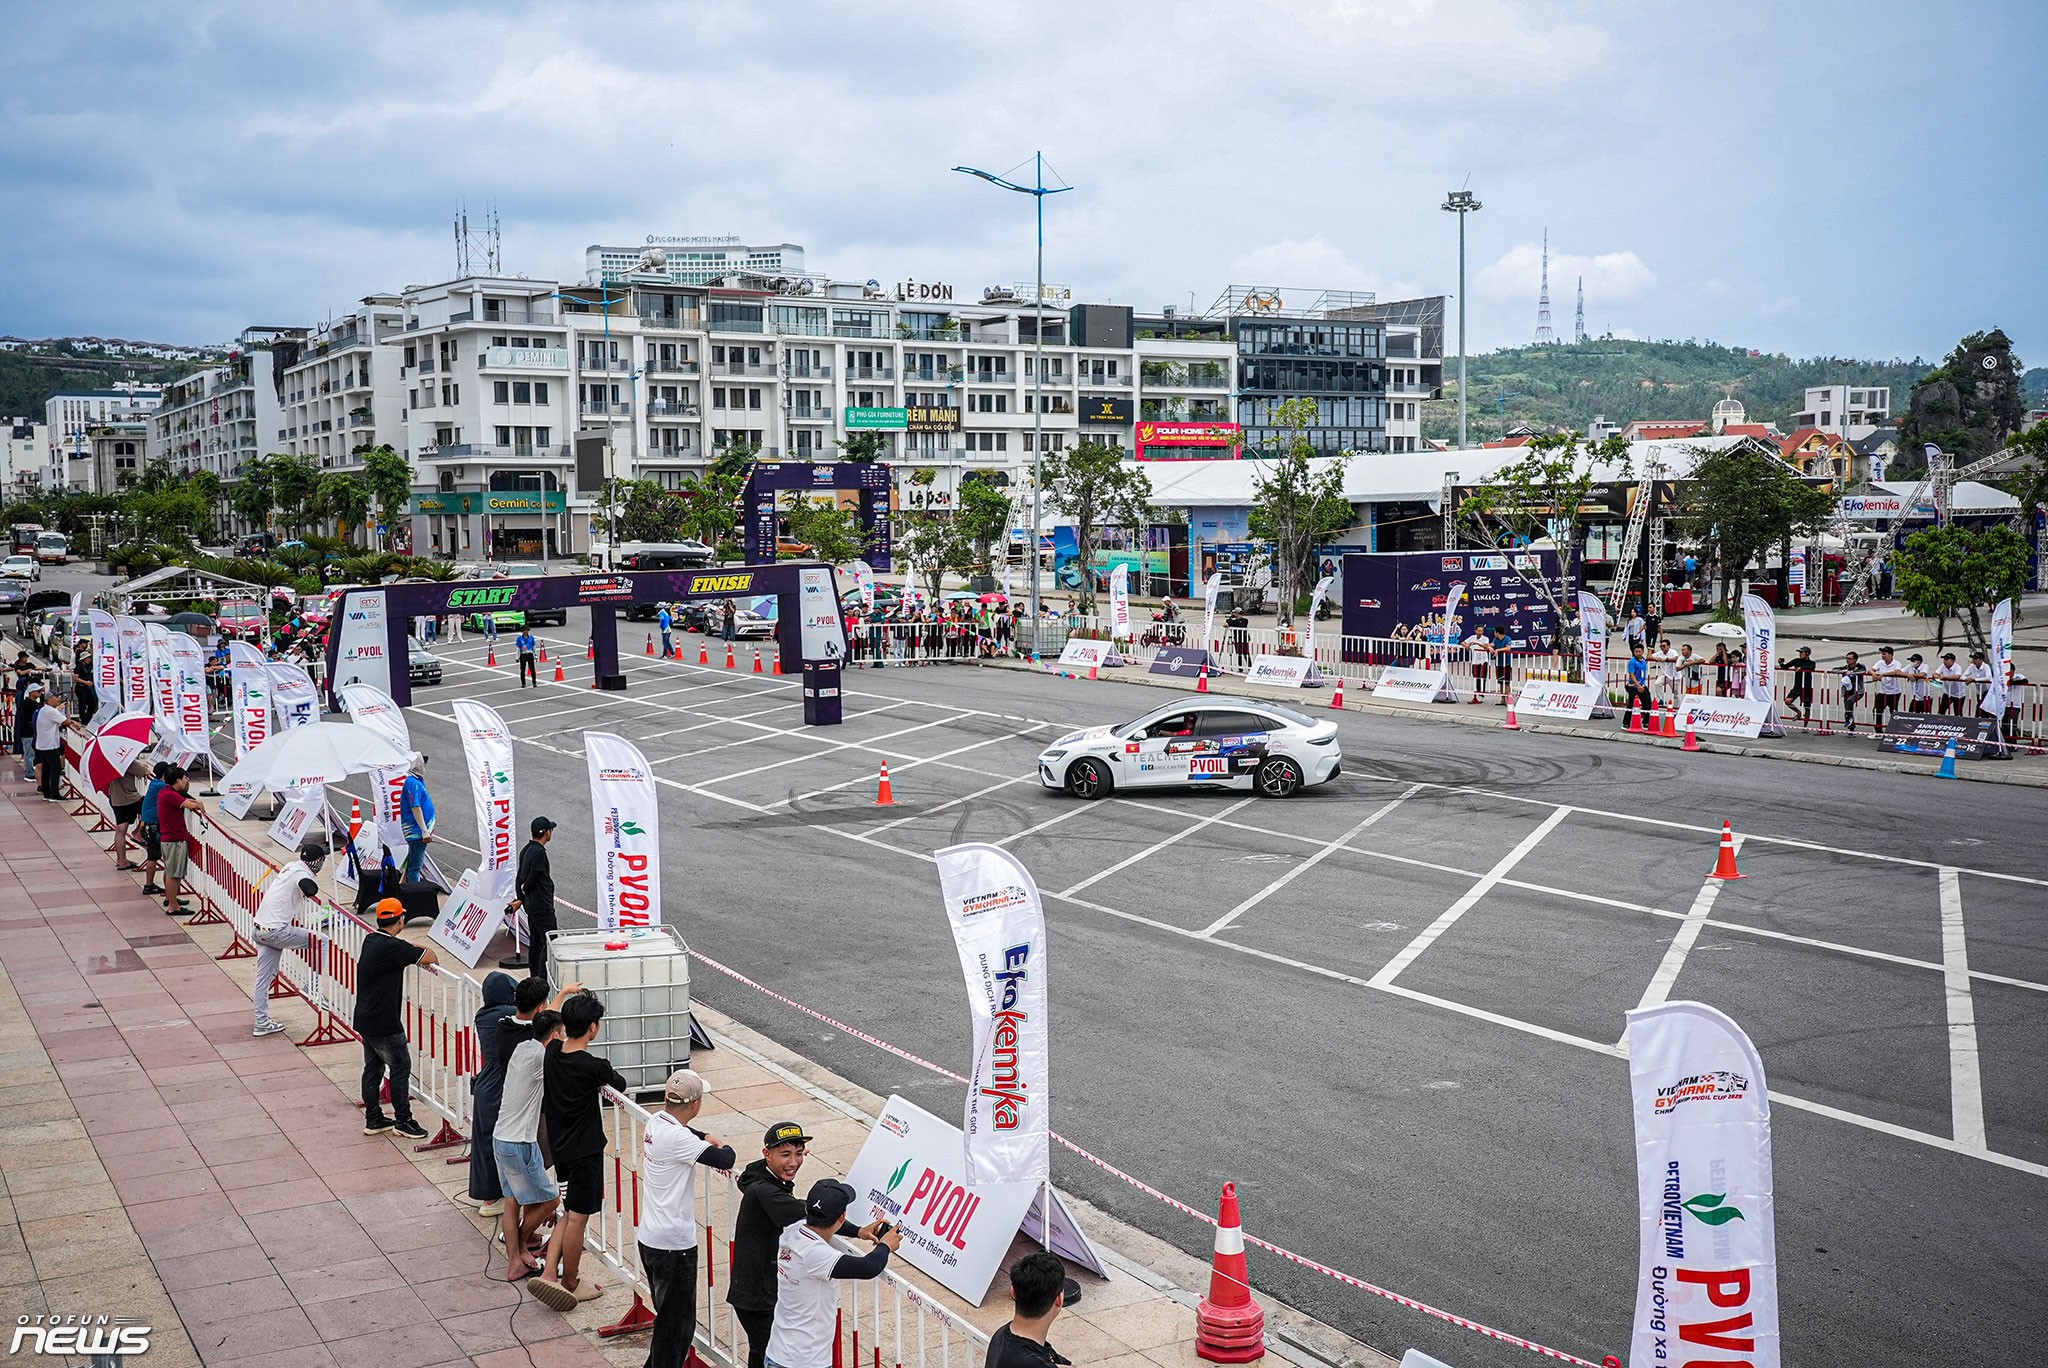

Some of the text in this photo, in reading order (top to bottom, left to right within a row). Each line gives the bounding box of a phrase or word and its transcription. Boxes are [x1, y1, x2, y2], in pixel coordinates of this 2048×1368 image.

[898, 278, 952, 300] LÊ DƠN
[516, 352, 556, 363] GEMINI
[930, 406, 957, 422] MÀNH
[489, 498, 557, 509] Gemini Coee
[909, 490, 923, 504] Lê
[1844, 498, 1900, 512] Ekokemika
[690, 574, 752, 594] FINISH
[1474, 576, 1491, 586] Ford
[449, 586, 516, 607] START
[817, 616, 835, 625] PVOIL
[1114, 600, 1128, 625] PVOIL
[358, 646, 383, 657] PVOIL
[1588, 641, 1601, 672] PVOIL
[1756, 629, 1770, 687] Ekokemika
[102, 655, 115, 688] PVOIL
[131, 666, 145, 701] PVOIL
[1393, 681, 1432, 689] HANKOOK
[160, 679, 175, 717] PVOIL
[1547, 693, 1579, 709] PVOIL
[183, 694, 202, 735] PVOIL
[1917, 723, 1967, 732] ANNIVERSARY
[1896, 738, 1976, 752] 22 9 16
[1190, 759, 1226, 773] PVOIL
[388, 774, 406, 821] VOIL
[494, 799, 509, 870] PVOIL
[608, 882, 614, 892] xa
[618, 852, 650, 933] PVOIL
[608, 894, 616, 915] thêm
[963, 892, 998, 905] VIETNAM
[963, 896, 1009, 913] GYMKHANA
[456, 902, 488, 941] PVOIL
[979, 953, 995, 1003] DUNG DỊCH
[980, 943, 1030, 1130] Ekokemika
[603, 1088, 625, 1110] THÔNG
[868, 1188, 902, 1217] PETROVIETNAM
[903, 1167, 981, 1251] PVOIL
[1664, 1161, 1684, 1259] PETROVIETNAM
[917, 1235, 926, 1248] xa
[928, 1240, 944, 1259] thêm
[943, 1252, 958, 1268] gần
[907, 1290, 922, 1306] GIAO
[931, 1305, 951, 1327] THÔNG
[1650, 1266, 1668, 1360] Đường xa
